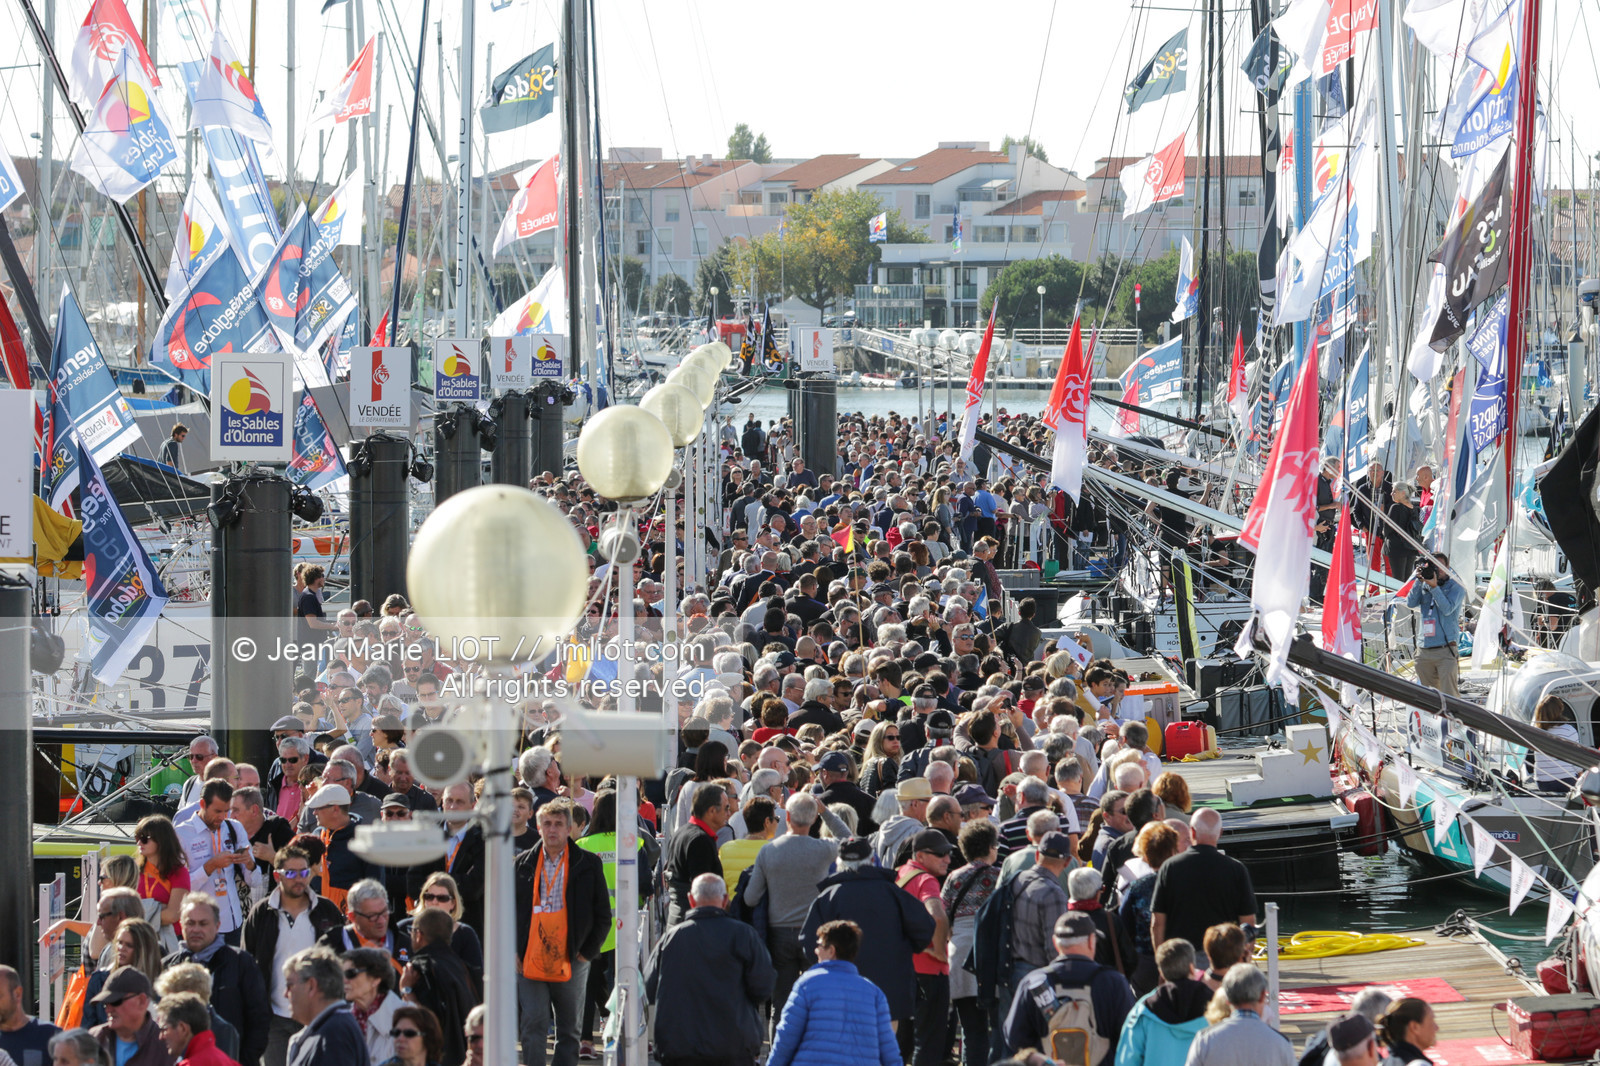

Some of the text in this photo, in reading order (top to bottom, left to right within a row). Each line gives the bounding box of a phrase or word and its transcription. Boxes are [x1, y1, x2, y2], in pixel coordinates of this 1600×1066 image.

[451, 378, 477, 388] Sables
[496, 374, 525, 382] VENDÉE
[438, 388, 473, 397] d'Olonne
[358, 404, 401, 417] VENDÉE
[228, 416, 280, 430] les Sables
[223, 429, 274, 443] d'Olonne
